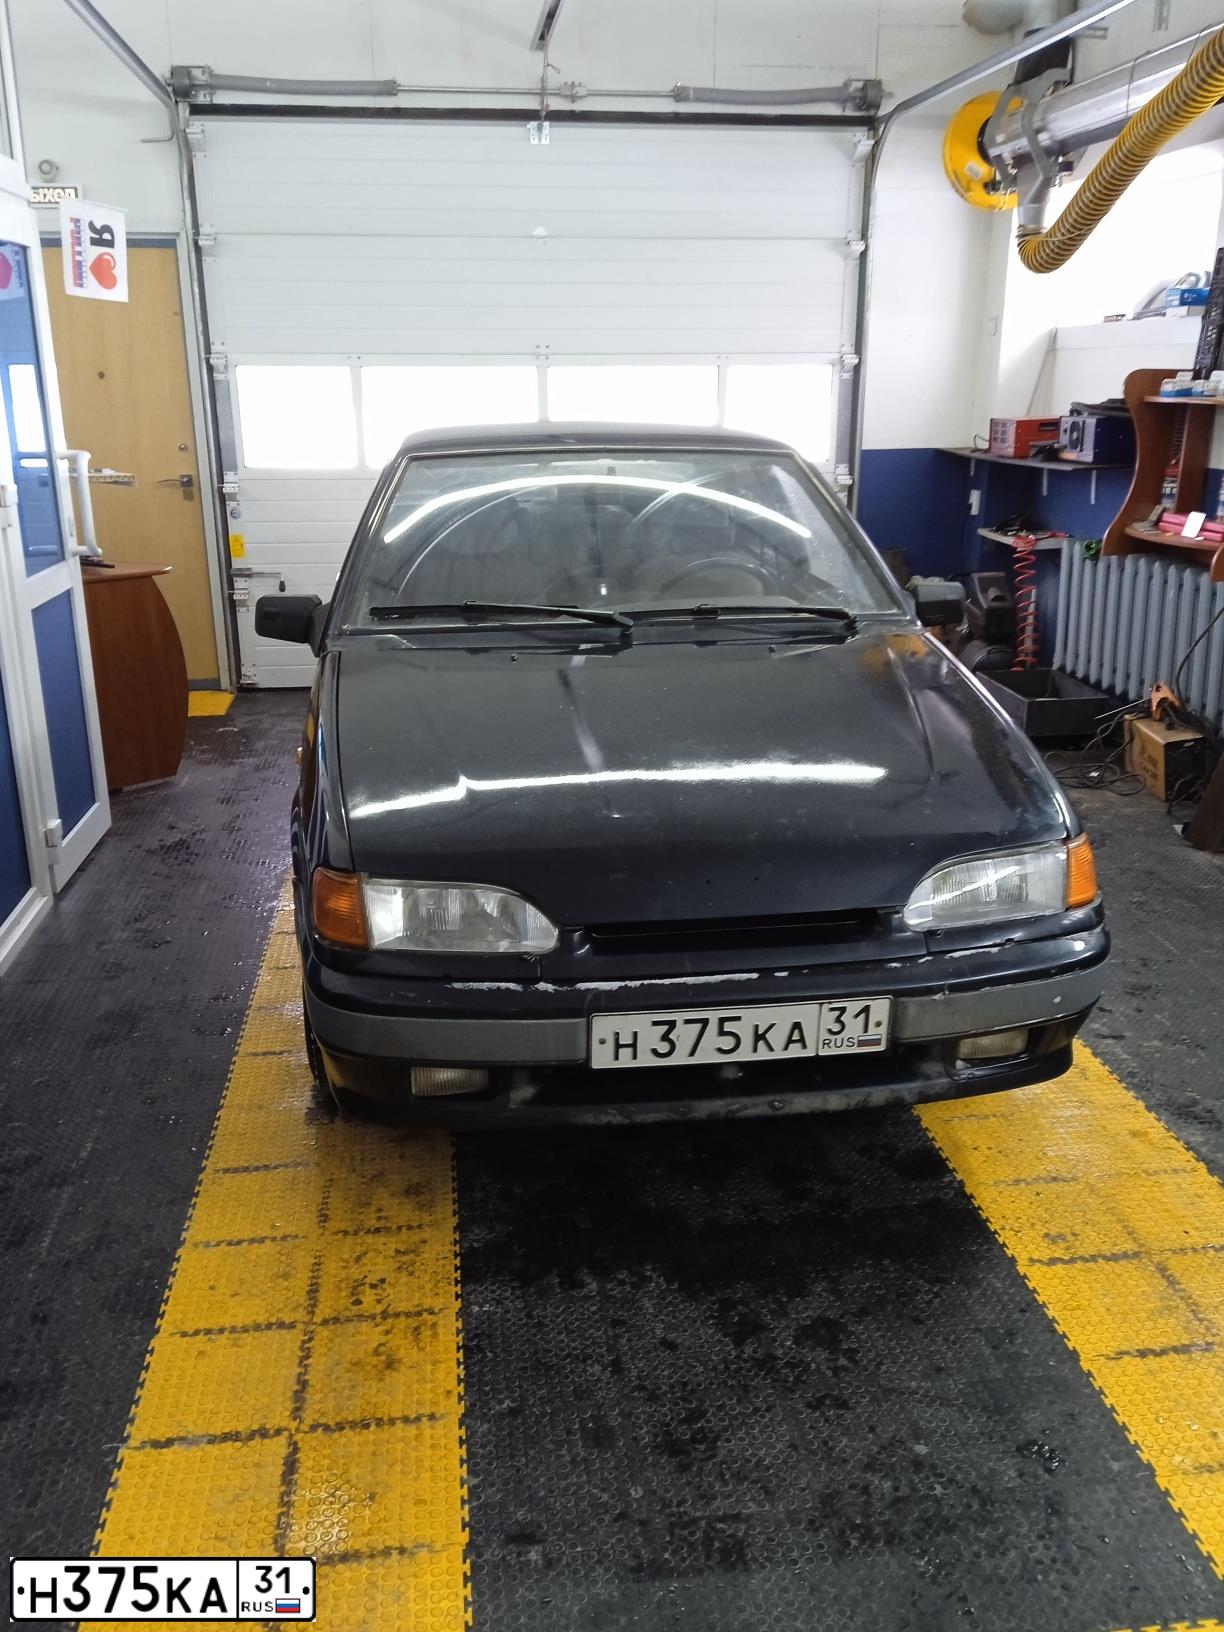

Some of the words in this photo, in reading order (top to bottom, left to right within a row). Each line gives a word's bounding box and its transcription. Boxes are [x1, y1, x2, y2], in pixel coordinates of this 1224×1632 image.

[88, 220, 115, 248] Я
[827, 1004, 872, 1036] 31
[822, 1036, 856, 1050] RUS
